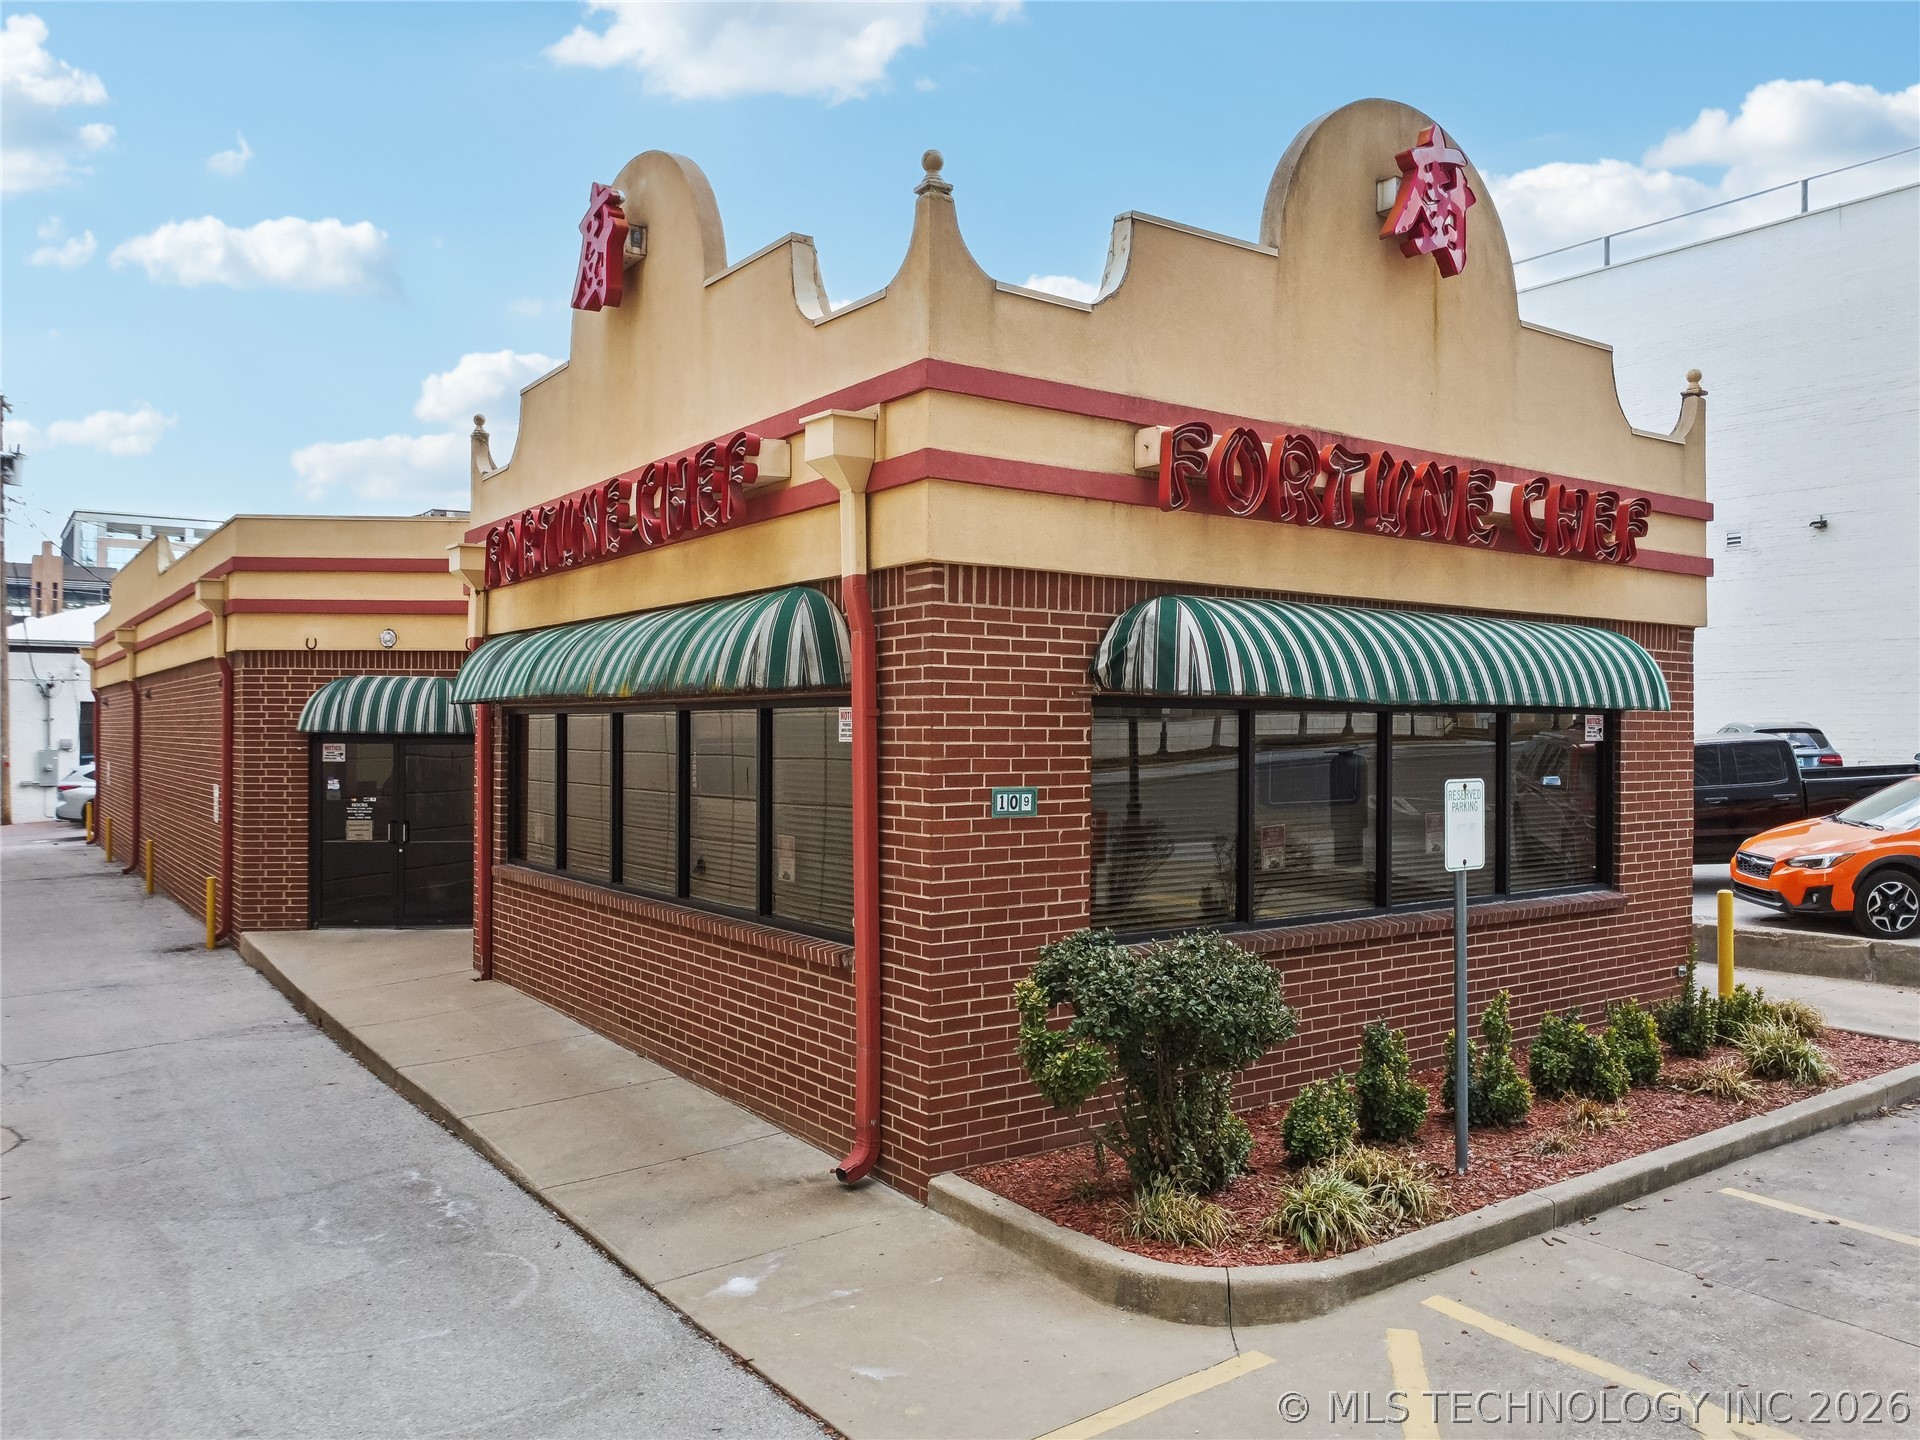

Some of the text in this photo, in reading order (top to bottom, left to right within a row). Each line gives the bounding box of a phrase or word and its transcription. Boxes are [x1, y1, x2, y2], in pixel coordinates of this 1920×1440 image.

[1158, 421, 1652, 565] FORTUNE CHEF
[485, 431, 761, 589] FORTUNE CHEF
[1448, 788, 1481, 800] RESERVED
[999, 795, 1030, 810] 109
[1451, 801, 1479, 813] PARKING
